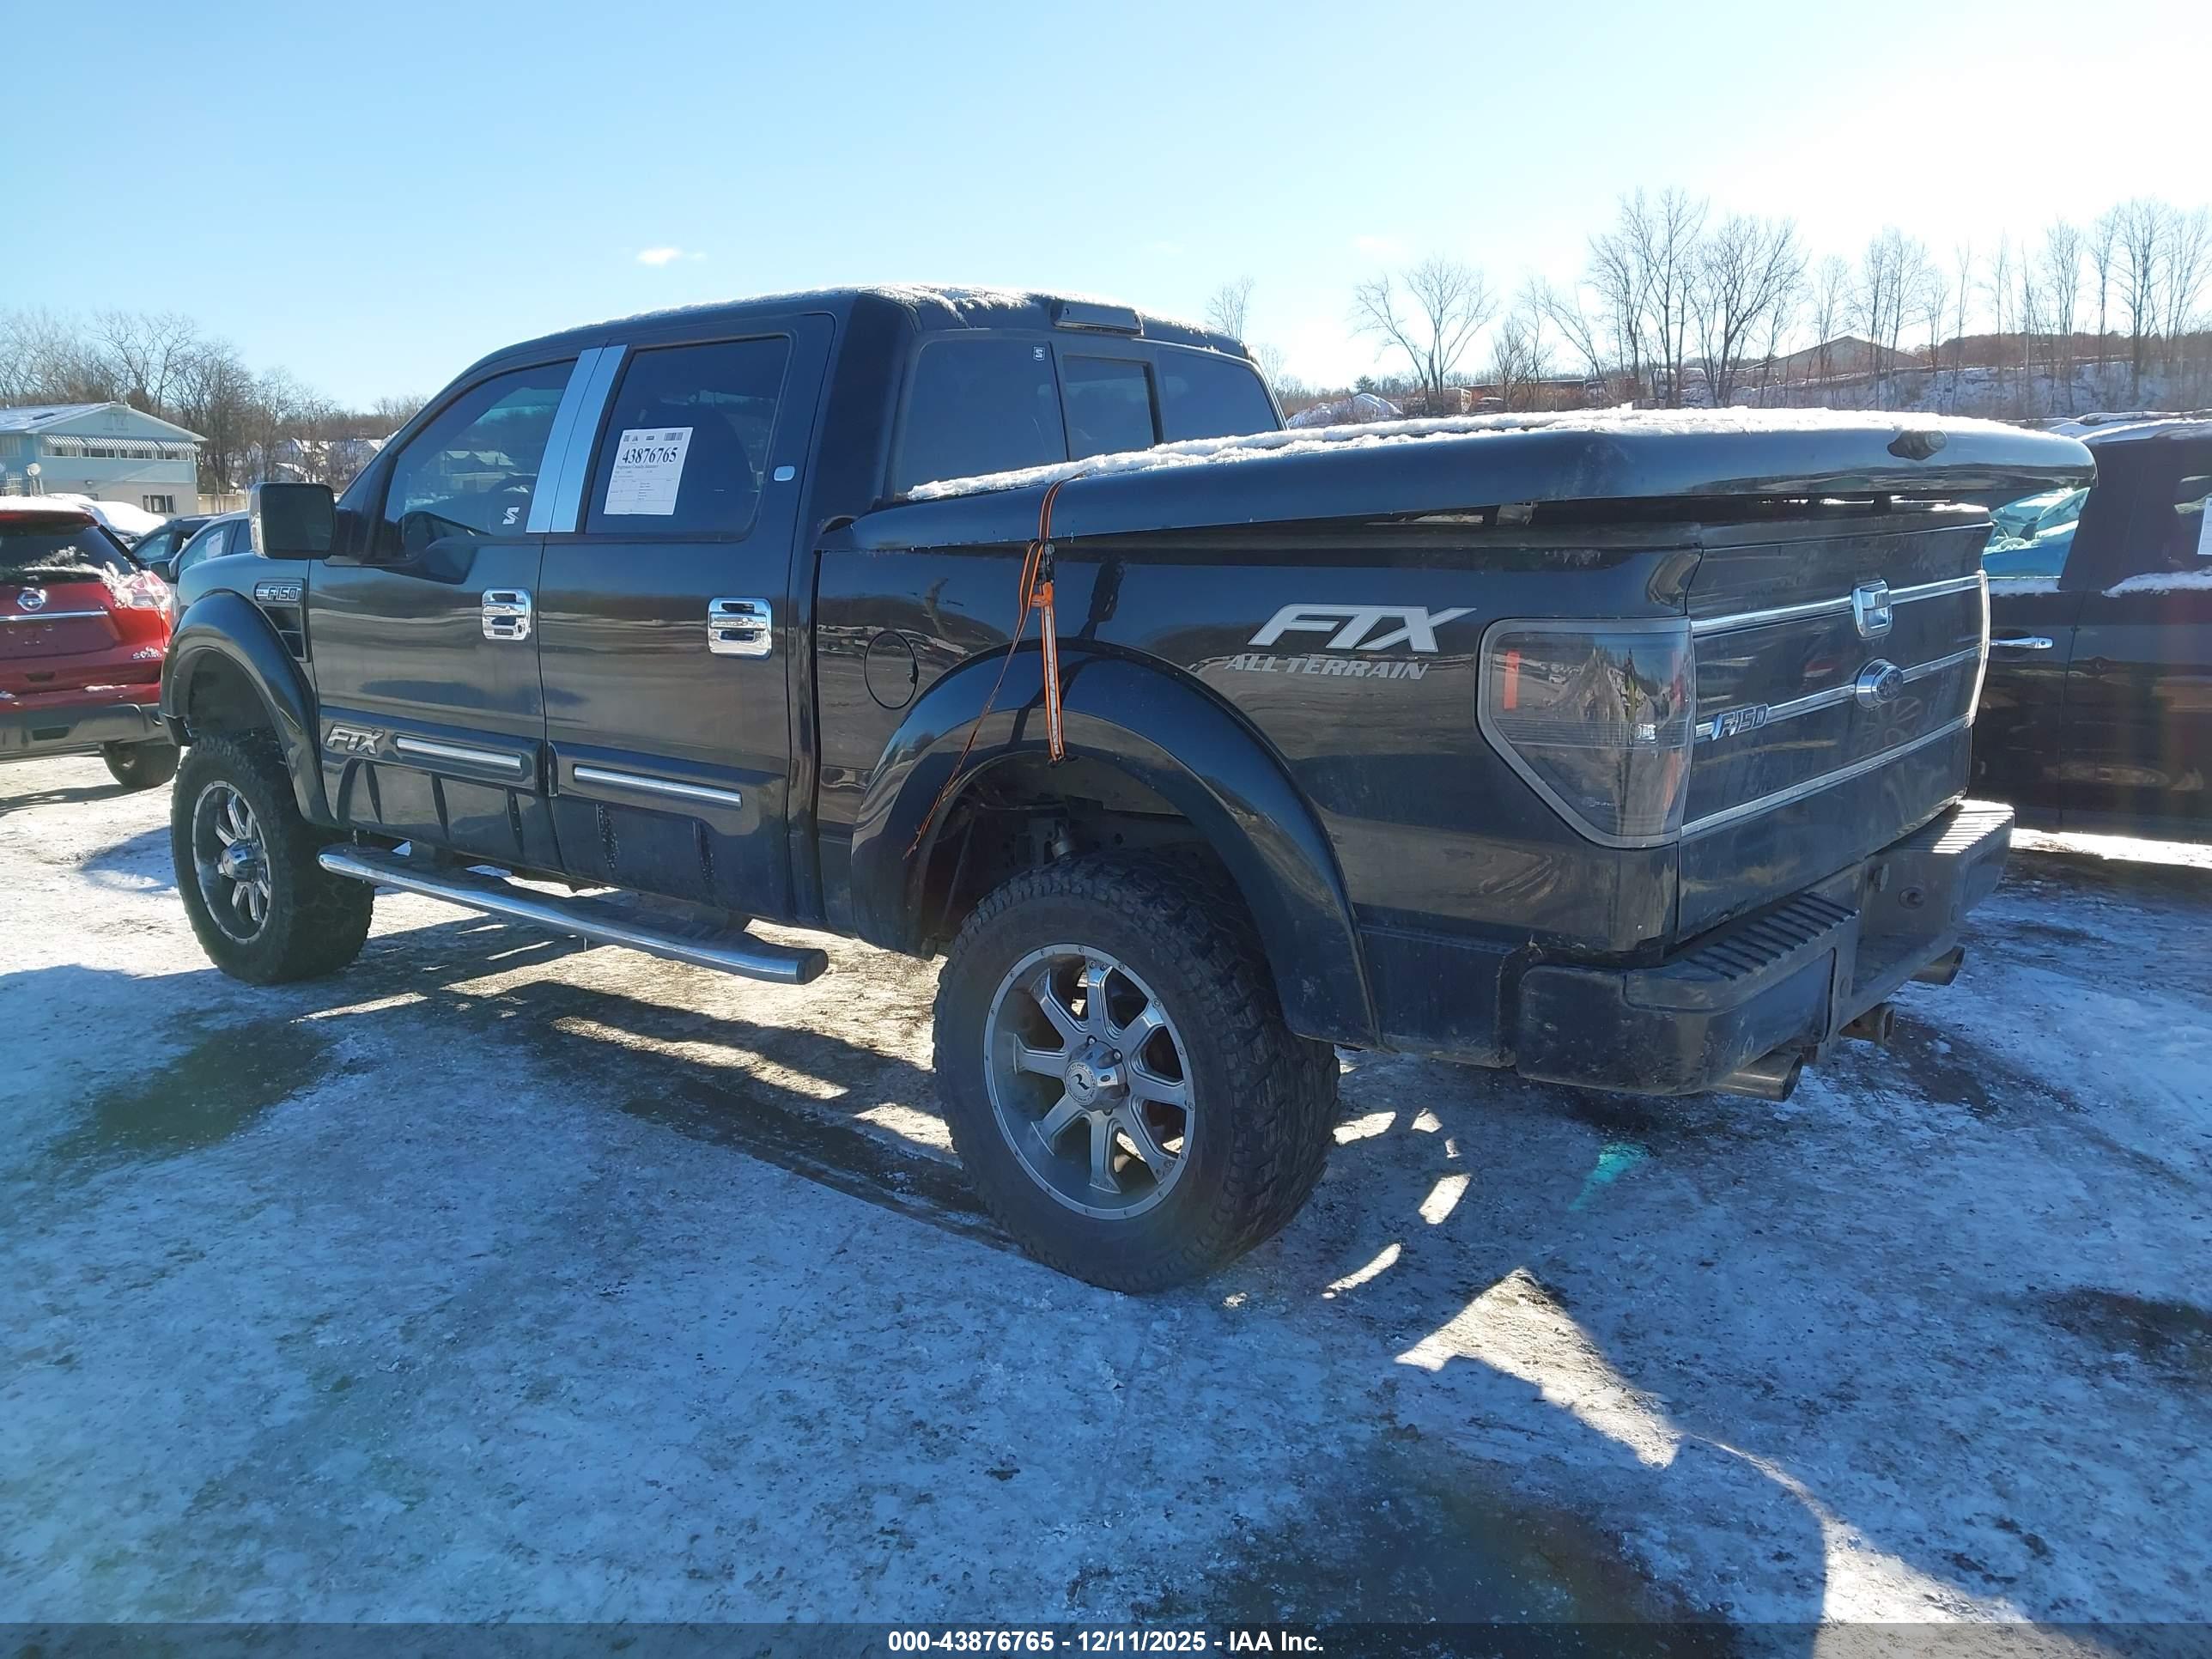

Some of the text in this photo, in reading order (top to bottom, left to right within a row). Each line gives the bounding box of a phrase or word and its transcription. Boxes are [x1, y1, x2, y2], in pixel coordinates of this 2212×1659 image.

[622, 447, 678, 464] 43876765
[1247, 604, 1477, 653] FTX
[1224, 654, 1429, 680] ALL TERRAIN
[326, 726, 385, 754] FTX
